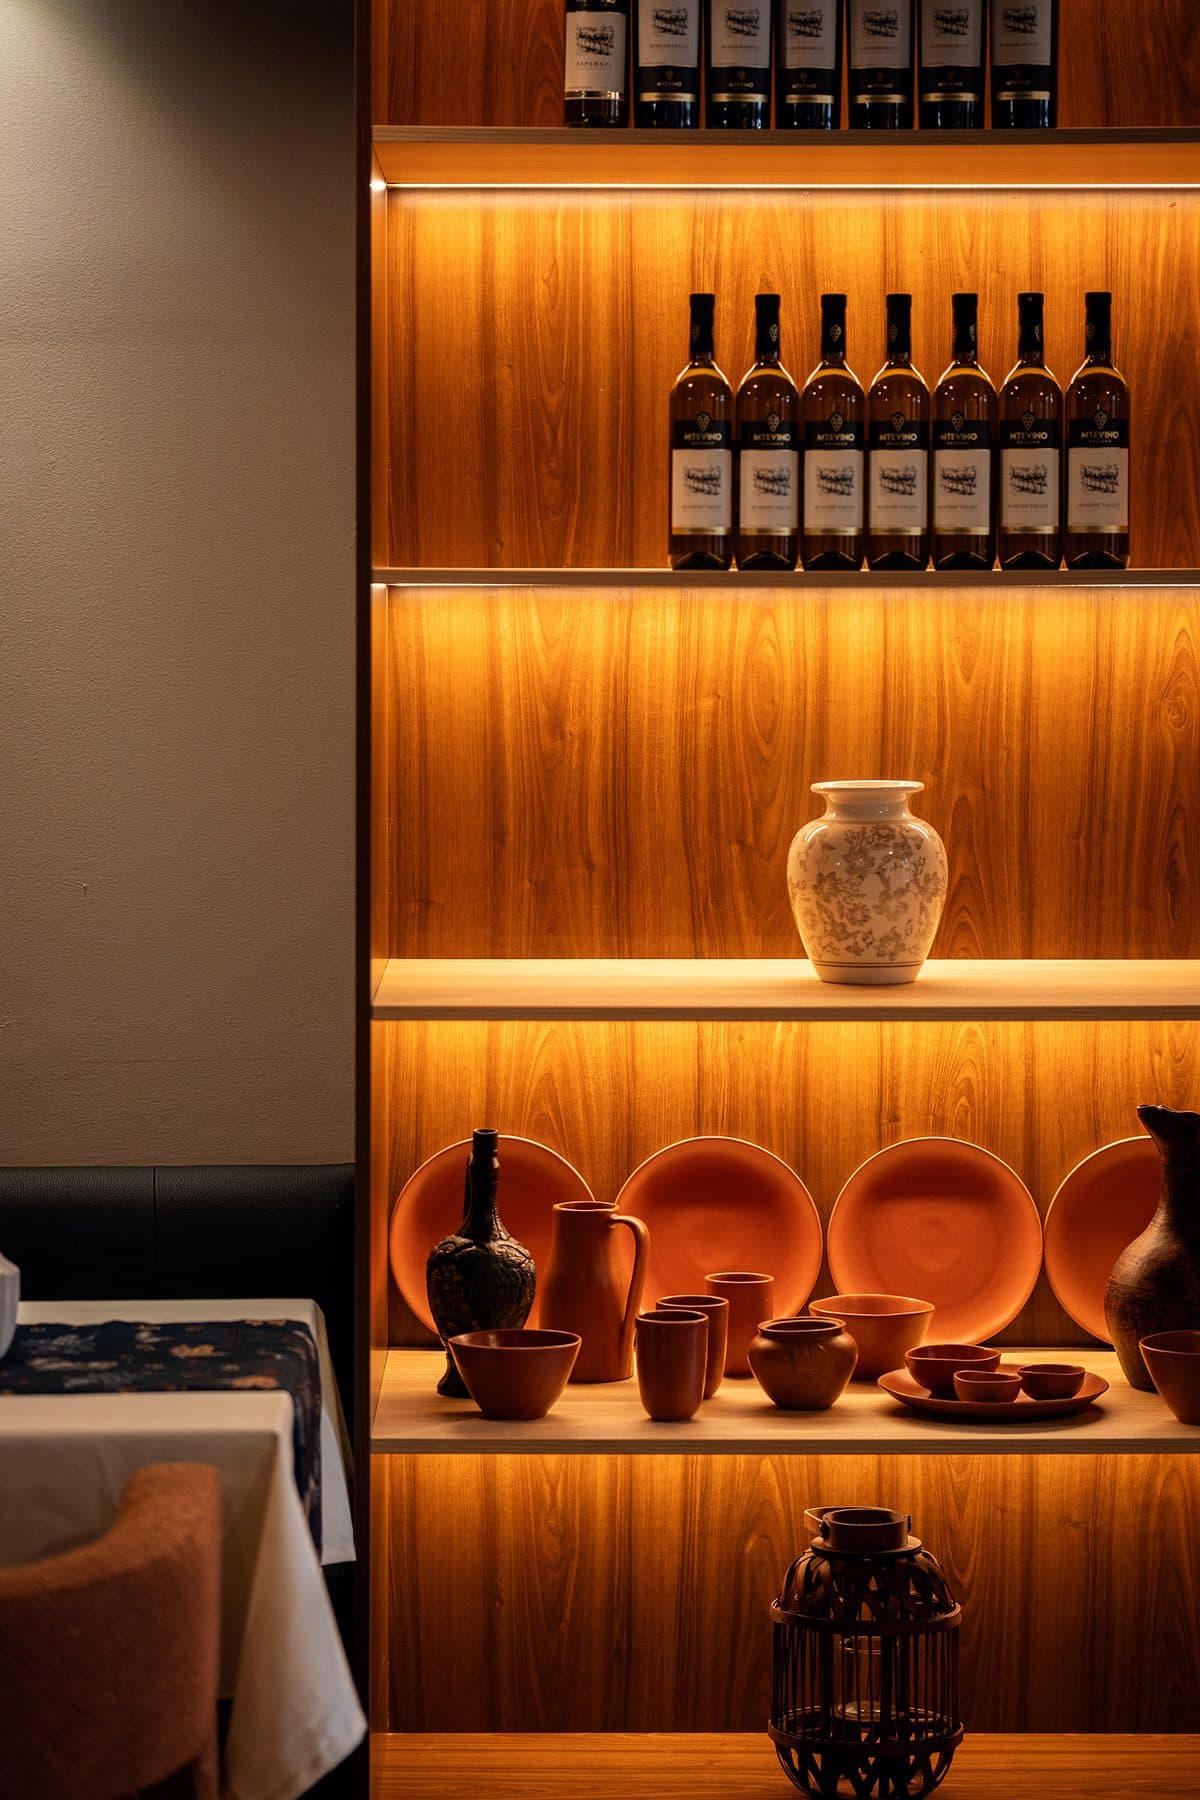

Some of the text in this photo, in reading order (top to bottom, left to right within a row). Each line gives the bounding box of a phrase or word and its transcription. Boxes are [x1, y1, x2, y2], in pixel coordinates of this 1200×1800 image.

[683, 432, 723, 441] MTEVINO
[752, 433, 792, 442] MTEVINO
[816, 433, 856, 442] MTEVINO
[879, 433, 918, 441] MTEVINO
[940, 432, 978, 441] MTEVINO
[1009, 431, 1048, 440] MTEVINO
[1080, 431, 1119, 439] MTEVINO
